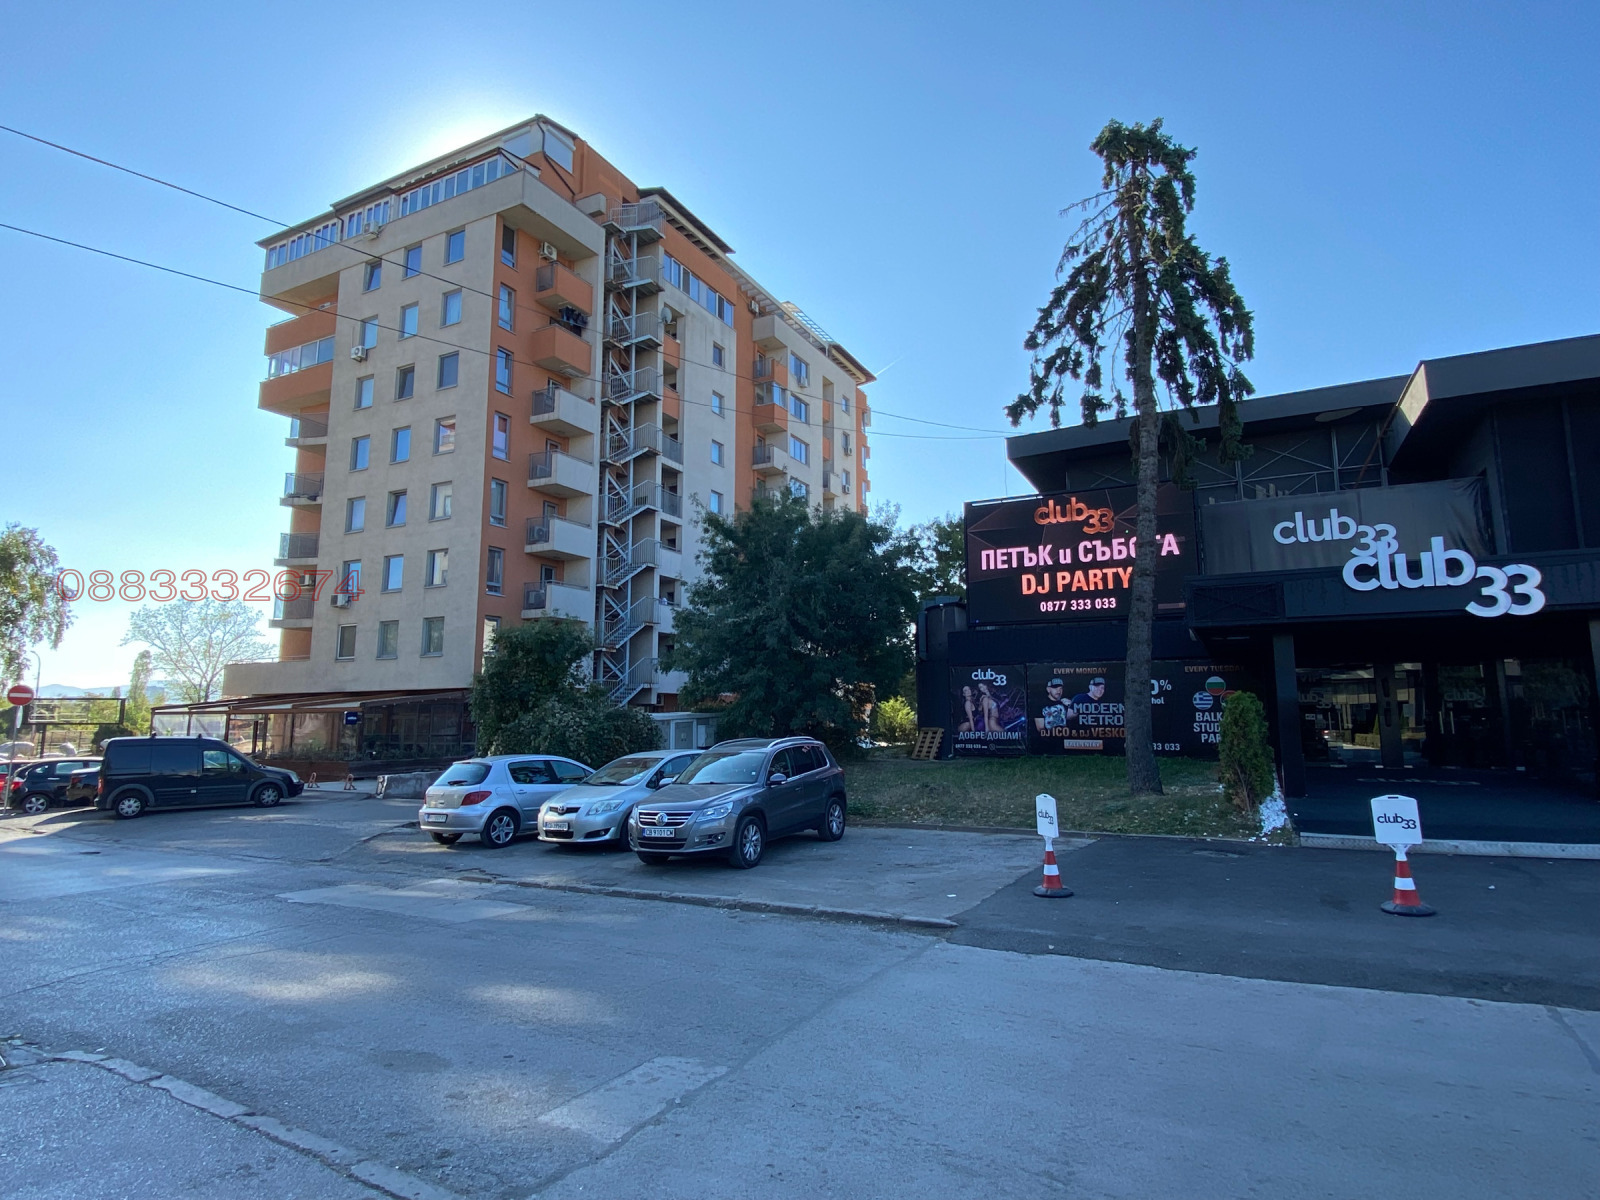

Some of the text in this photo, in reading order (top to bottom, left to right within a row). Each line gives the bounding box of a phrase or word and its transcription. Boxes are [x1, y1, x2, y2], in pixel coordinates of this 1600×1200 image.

[1033, 497, 1115, 534] club33
[1273, 508, 1399, 557] club33
[981, 545, 1053, 570] ПЕТЪК
[1022, 566, 1134, 595] DJ PARTY
[1342, 536, 1546, 618] club33
[1040, 598, 1116, 612] 0877 333 033
[1053, 667, 1108, 675] EVERY MONDAY
[1184, 665, 1208, 673] EVERY
[971, 668, 1007, 686] club33
[1150, 679, 1172, 695] 0%
[1073, 702, 1125, 714] MODERN
[1078, 714, 1124, 726] RETRO
[1195, 711, 1223, 722] BALK
[1040, 727, 1127, 738] DJ ICO & DJ VESKO
[1193, 722, 1221, 732] STUD
[958, 731, 985, 741] ДОБРЕ
[1200, 733, 1221, 743] PAR
[1037, 809, 1055, 825] club33
[1376, 812, 1418, 830] club33
